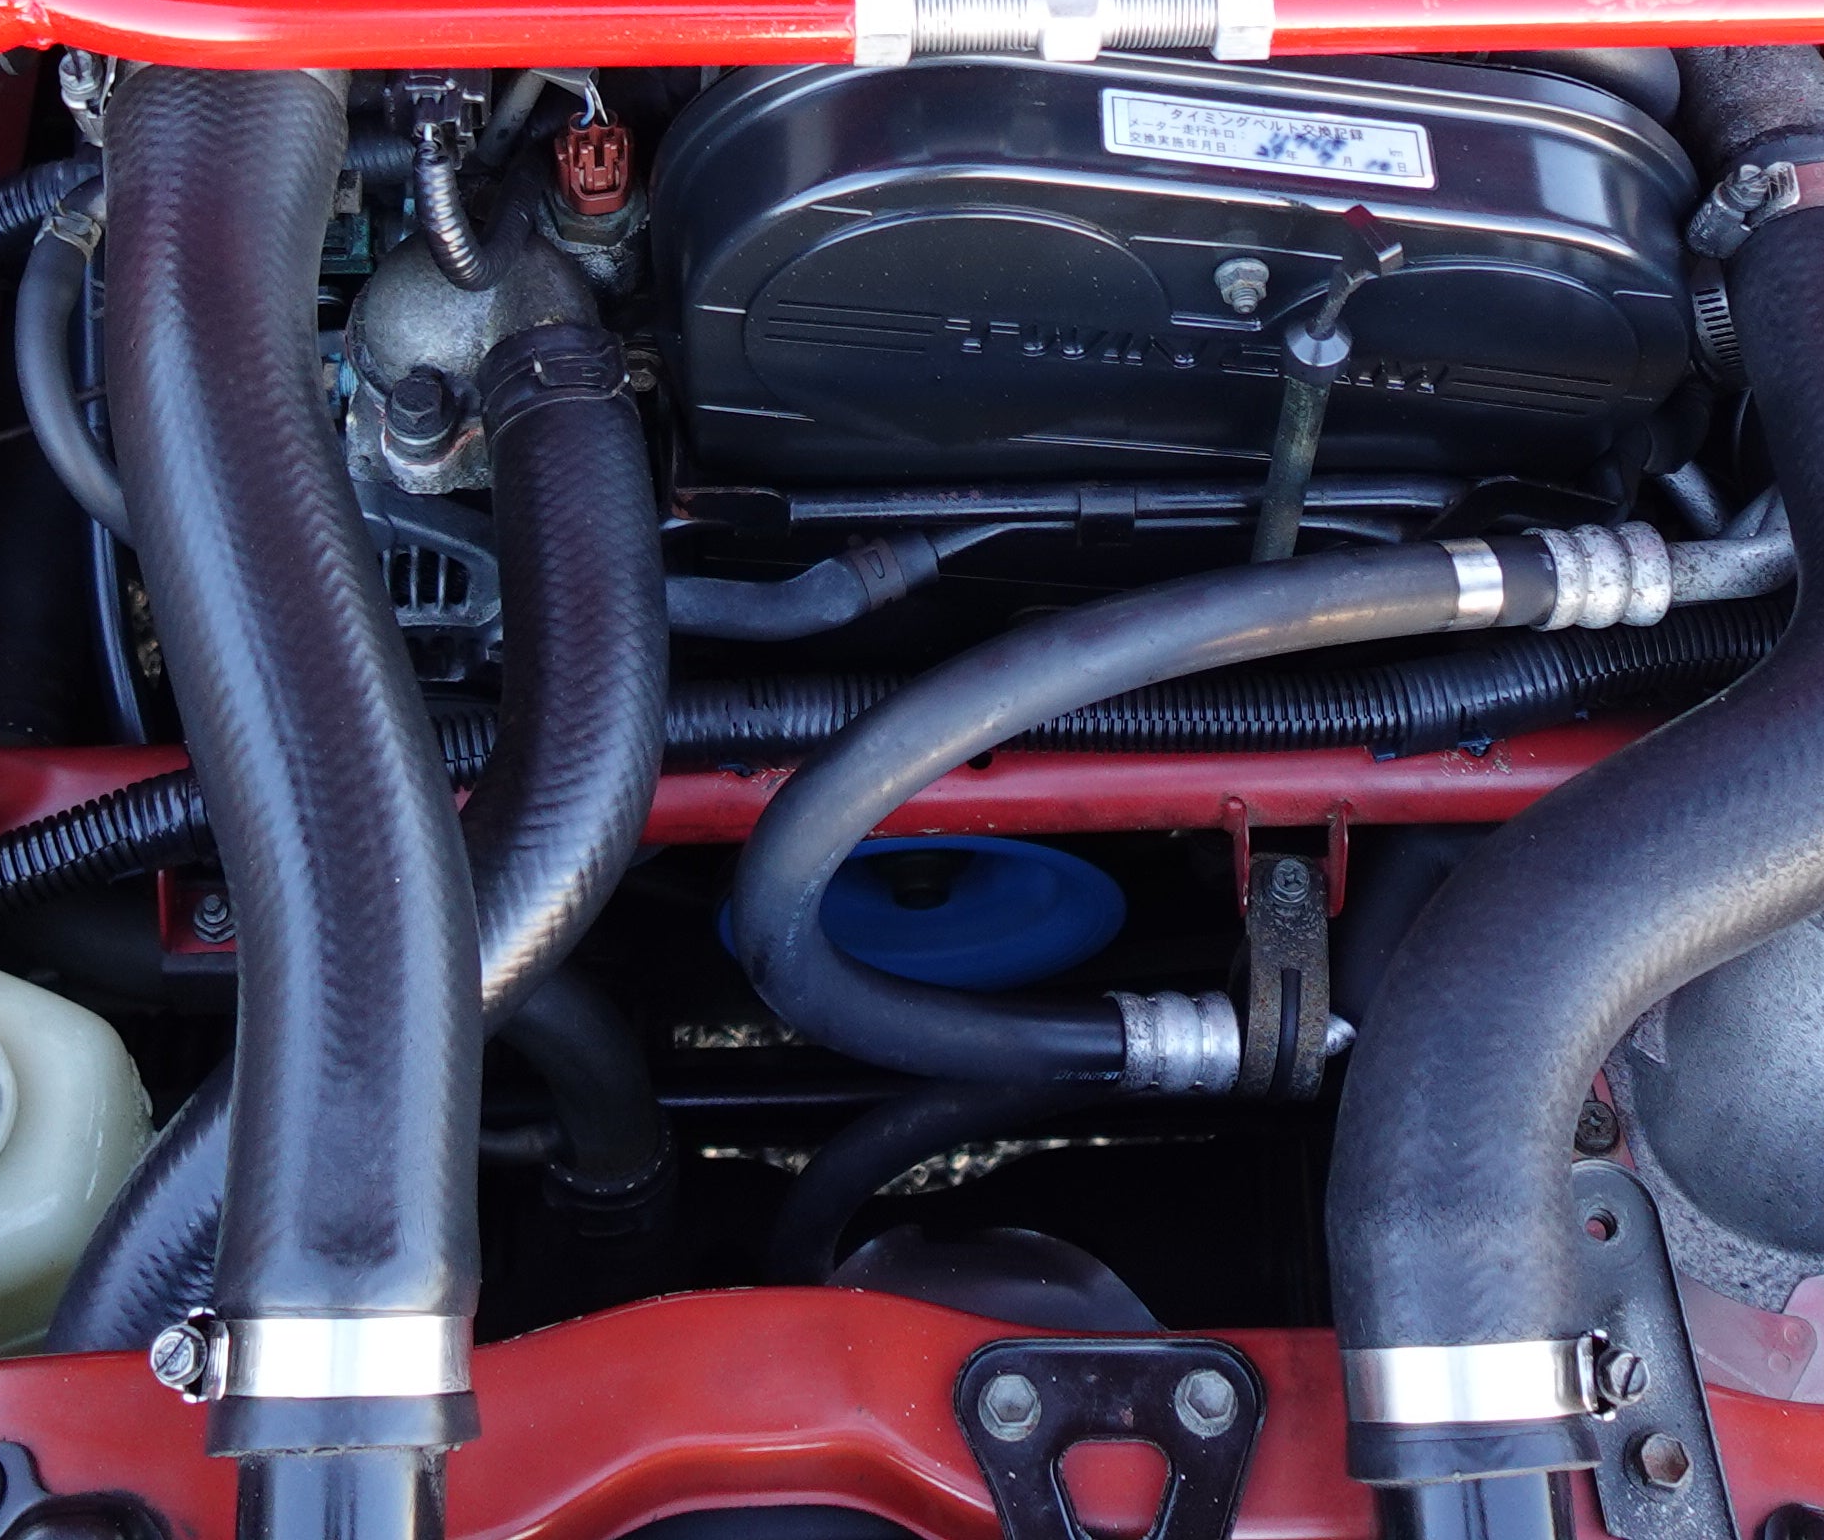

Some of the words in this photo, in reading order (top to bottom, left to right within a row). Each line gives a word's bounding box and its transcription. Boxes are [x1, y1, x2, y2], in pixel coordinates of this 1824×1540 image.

[1170, 106, 1365, 142] タイミングベルト交換記録
